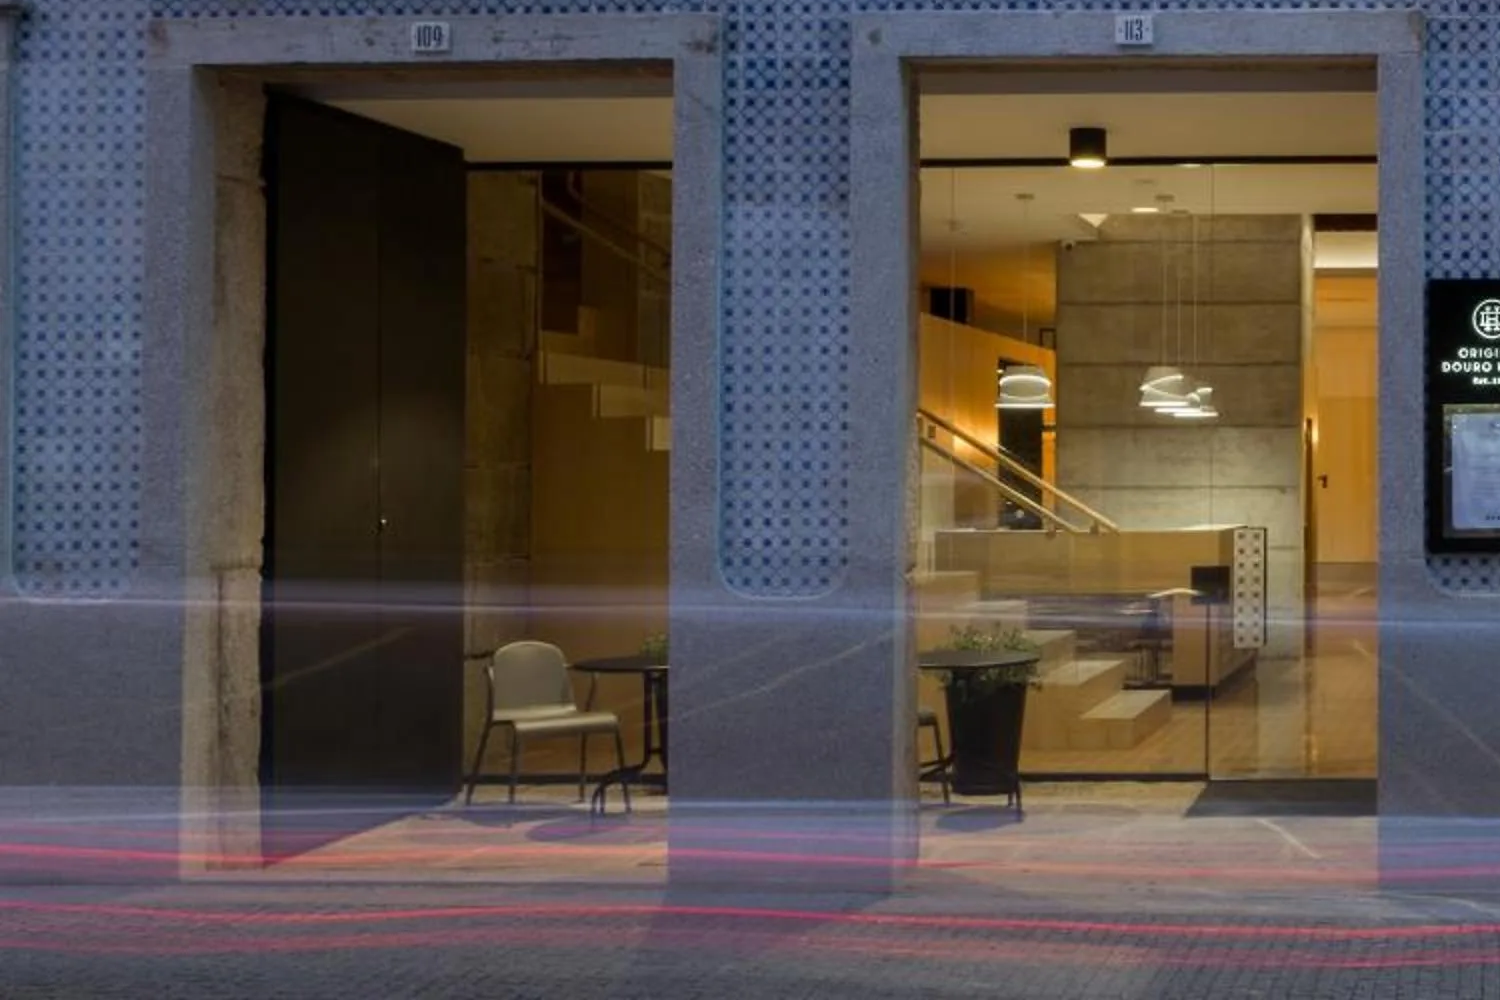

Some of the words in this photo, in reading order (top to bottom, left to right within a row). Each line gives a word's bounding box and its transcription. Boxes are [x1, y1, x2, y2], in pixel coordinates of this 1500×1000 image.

[416, 24, 443, 48] 109
[1124, 18, 1144, 41] 113
[1441, 361, 1493, 373] DOURO
